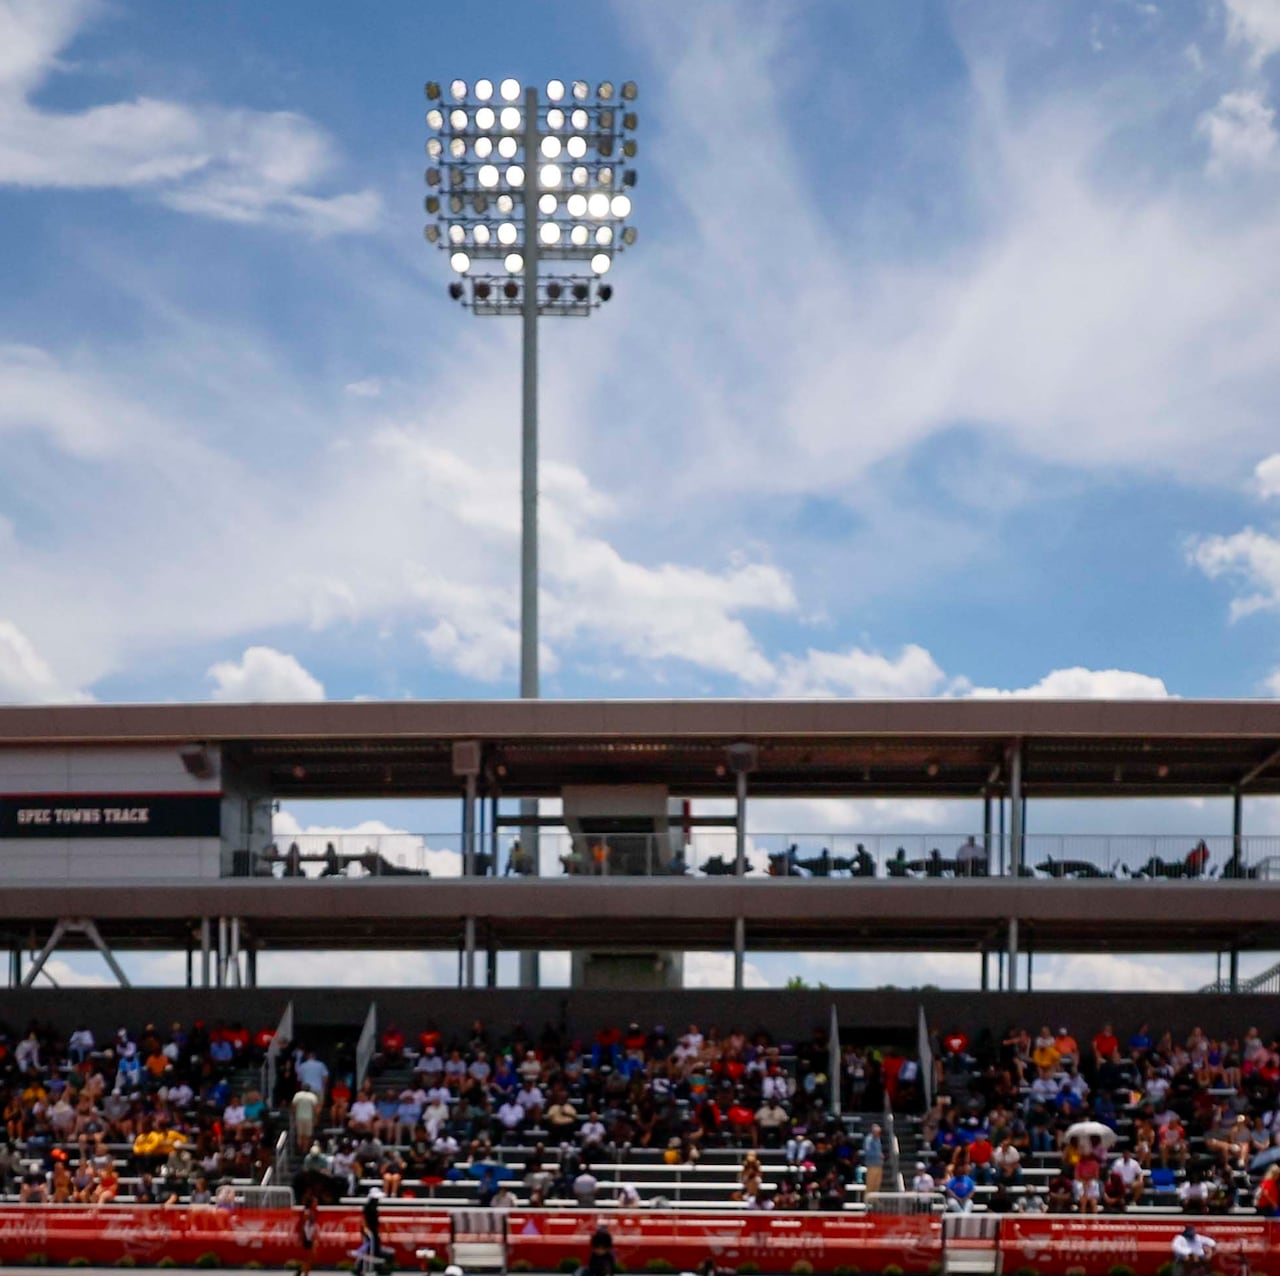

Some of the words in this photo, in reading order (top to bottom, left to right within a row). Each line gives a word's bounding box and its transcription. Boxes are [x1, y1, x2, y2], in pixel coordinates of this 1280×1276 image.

[17, 808, 51, 824] SPEC
[54, 808, 100, 824] TOWNS
[103, 807, 149, 823] TRACK
[269, 1221, 346, 1238] ATLNTA
